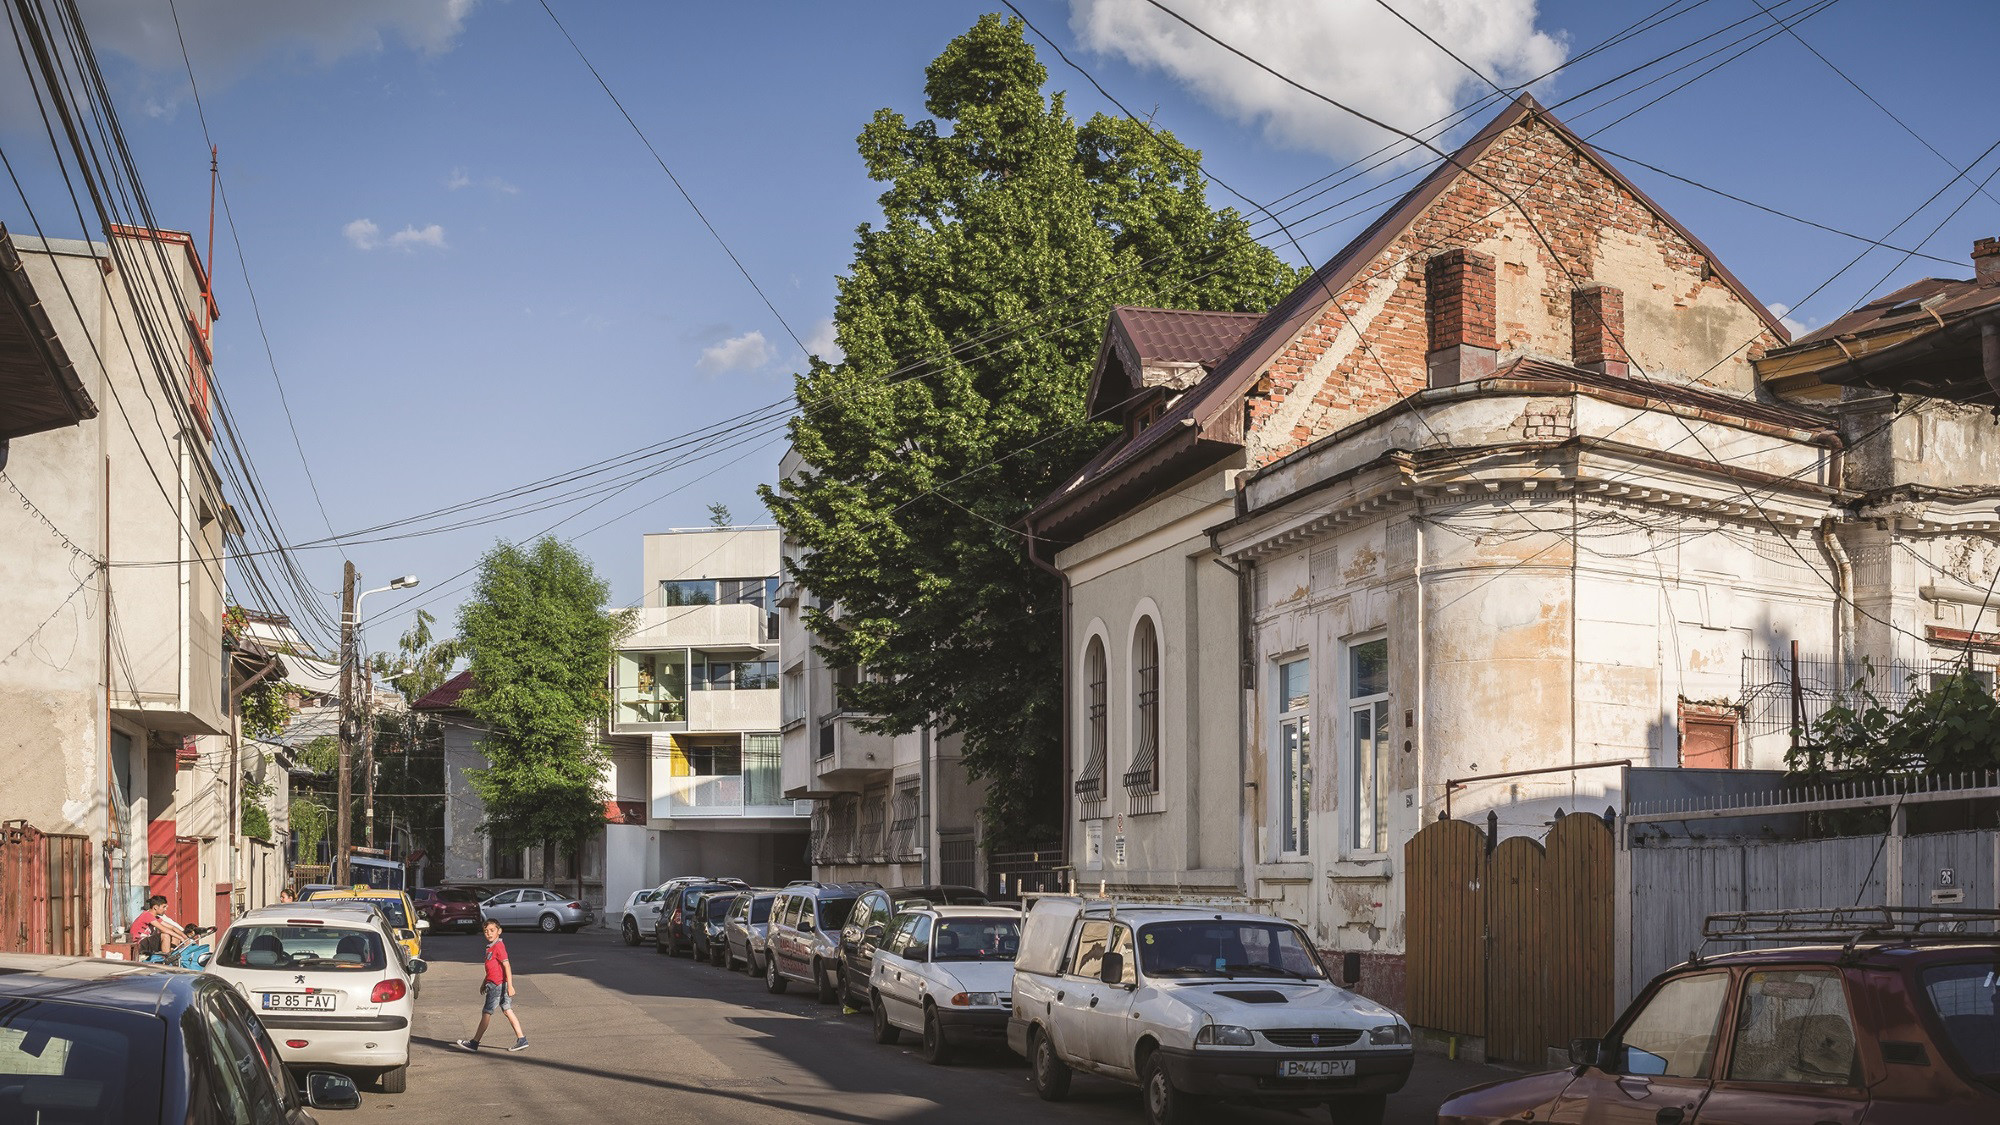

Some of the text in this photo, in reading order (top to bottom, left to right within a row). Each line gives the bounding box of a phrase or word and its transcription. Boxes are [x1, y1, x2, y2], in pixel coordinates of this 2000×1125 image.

[271, 994, 281, 1007] B
[285, 995, 300, 1007] 85
[305, 996, 331, 1008] FAV
[1288, 1061, 1299, 1075] B
[1320, 1060, 1349, 1075] DPY
